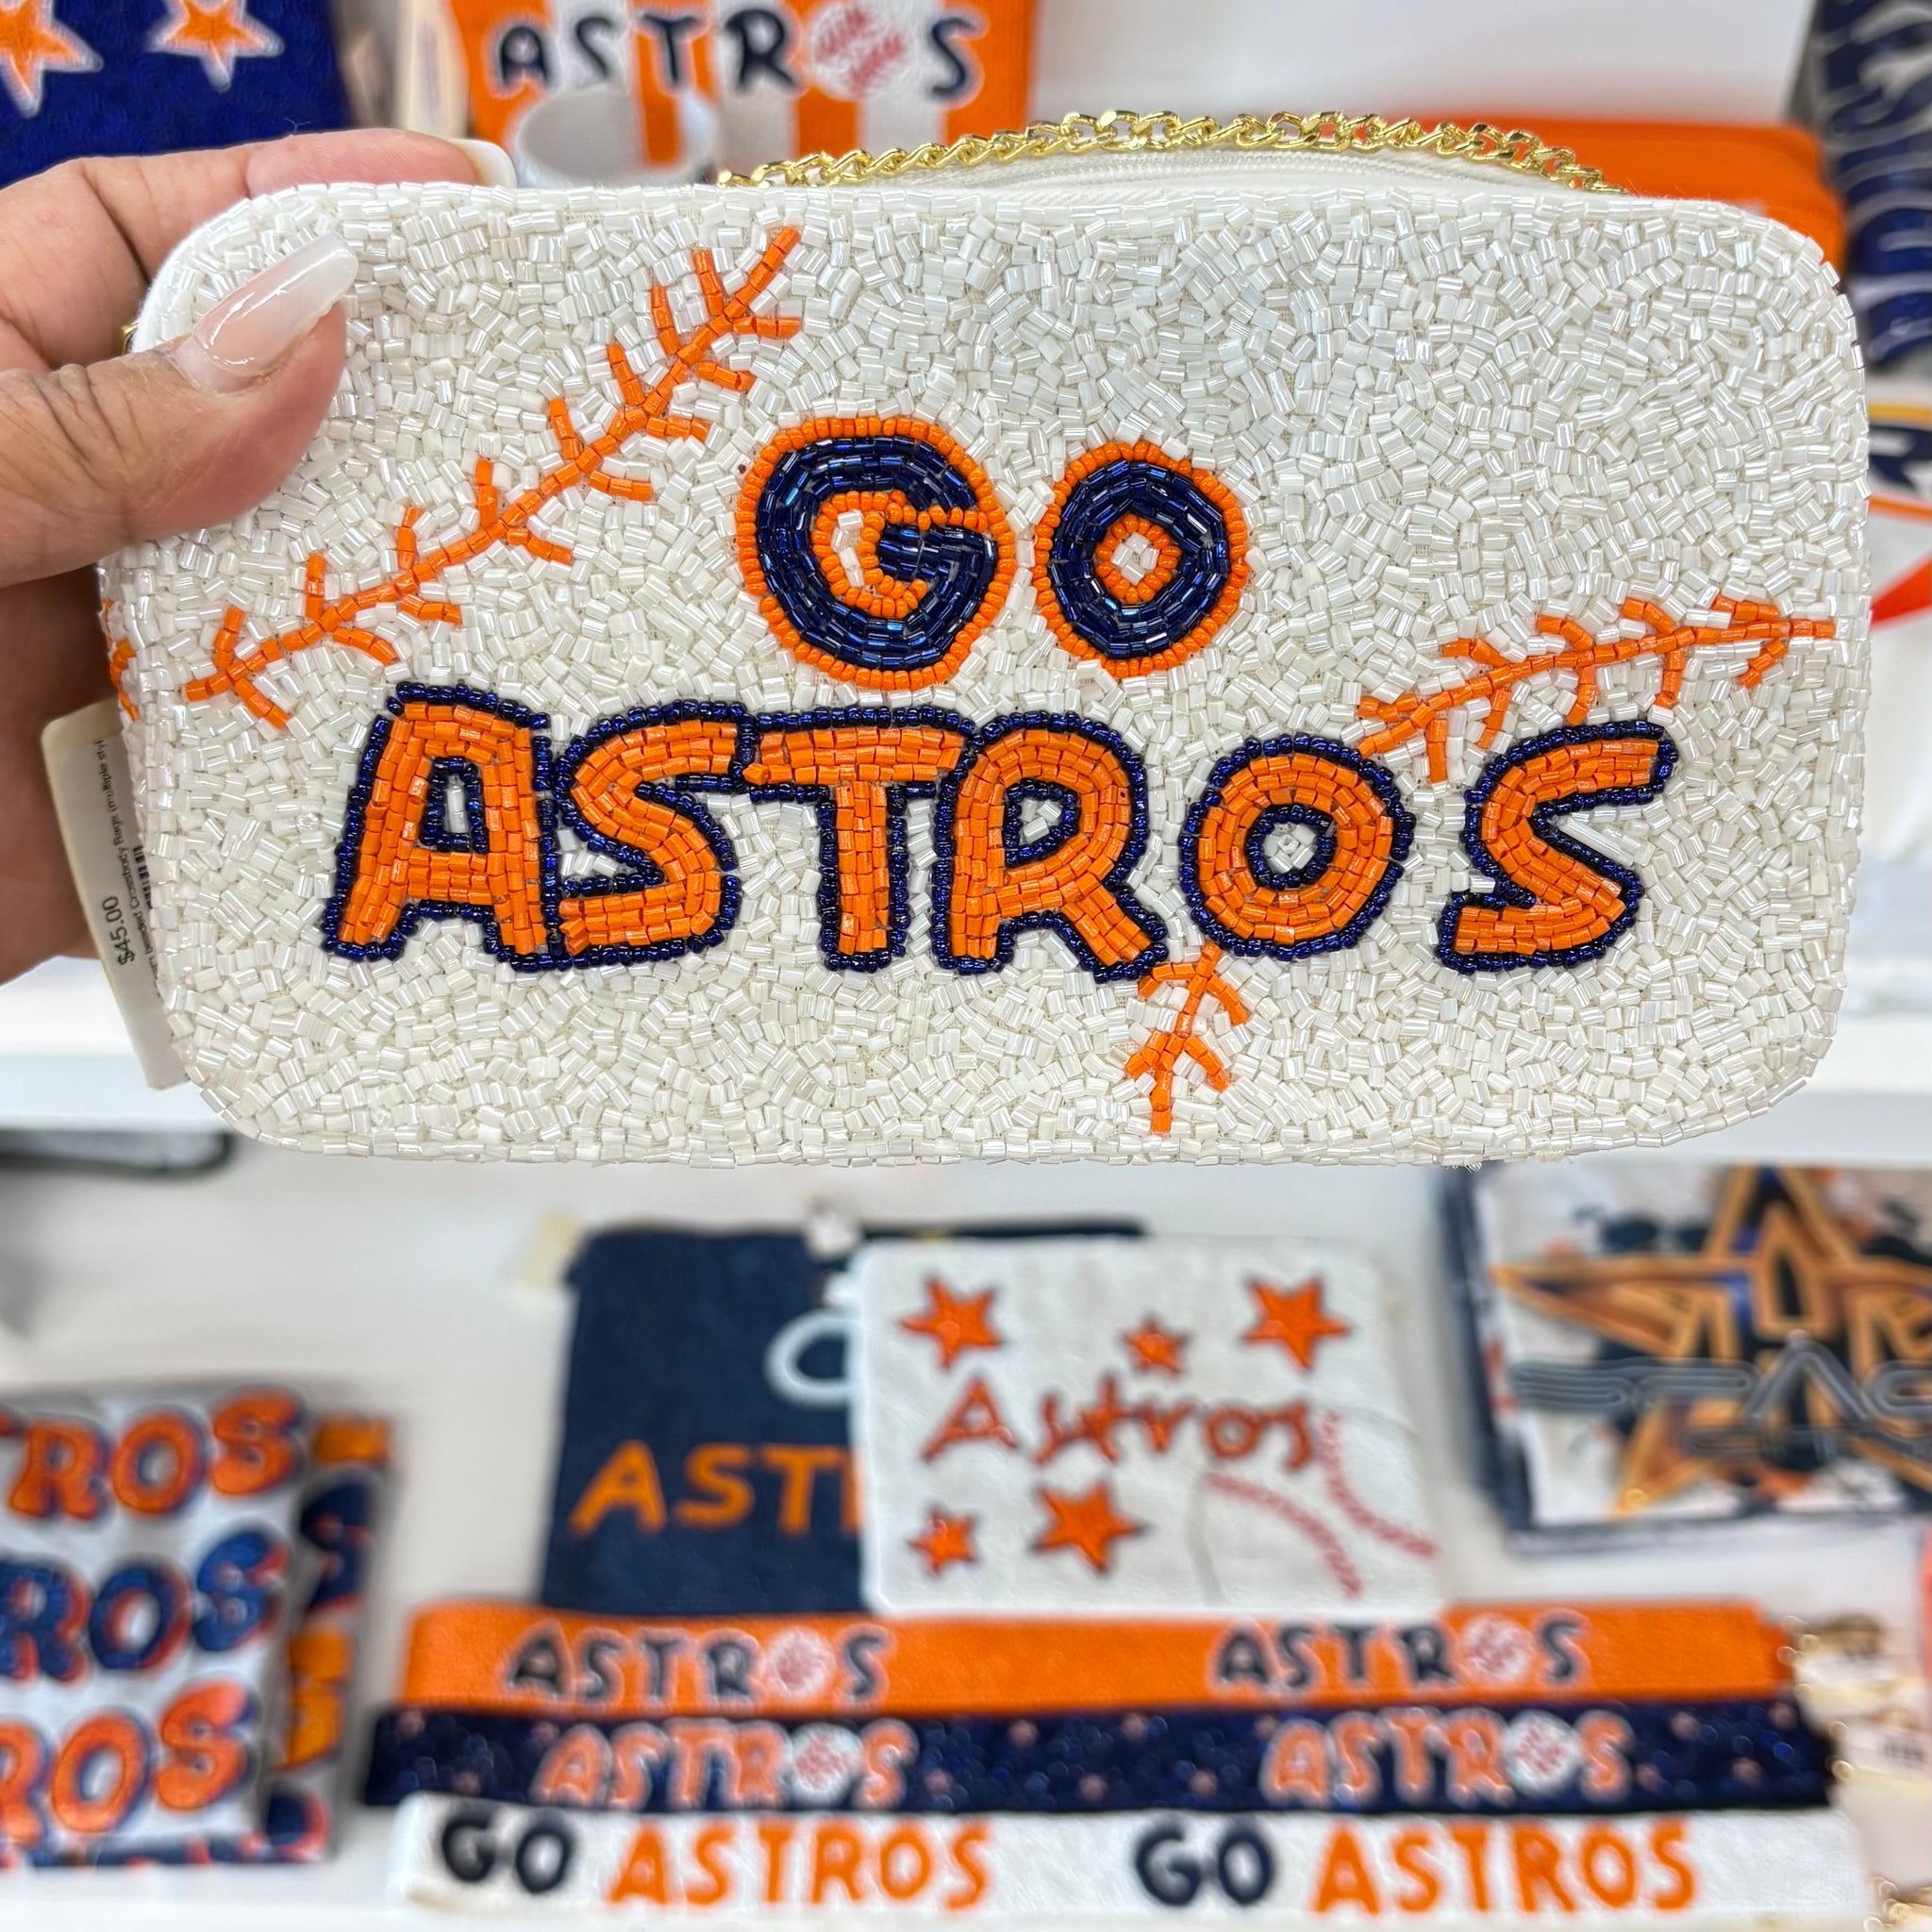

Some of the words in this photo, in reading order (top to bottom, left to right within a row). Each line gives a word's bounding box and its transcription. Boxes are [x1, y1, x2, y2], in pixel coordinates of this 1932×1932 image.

[738, 413, 1251, 688] GO
[321, 680, 1678, 979] ASTROS
[102, 894, 136, 966] $45.00
[0, 1391, 302, 1520] ROS
[440, 1806, 575, 1895] GO
[604, 1815, 993, 1911] ASTROS
[1135, 1817, 1276, 1907] GO
[1311, 1817, 1696, 1915] ASTROS
